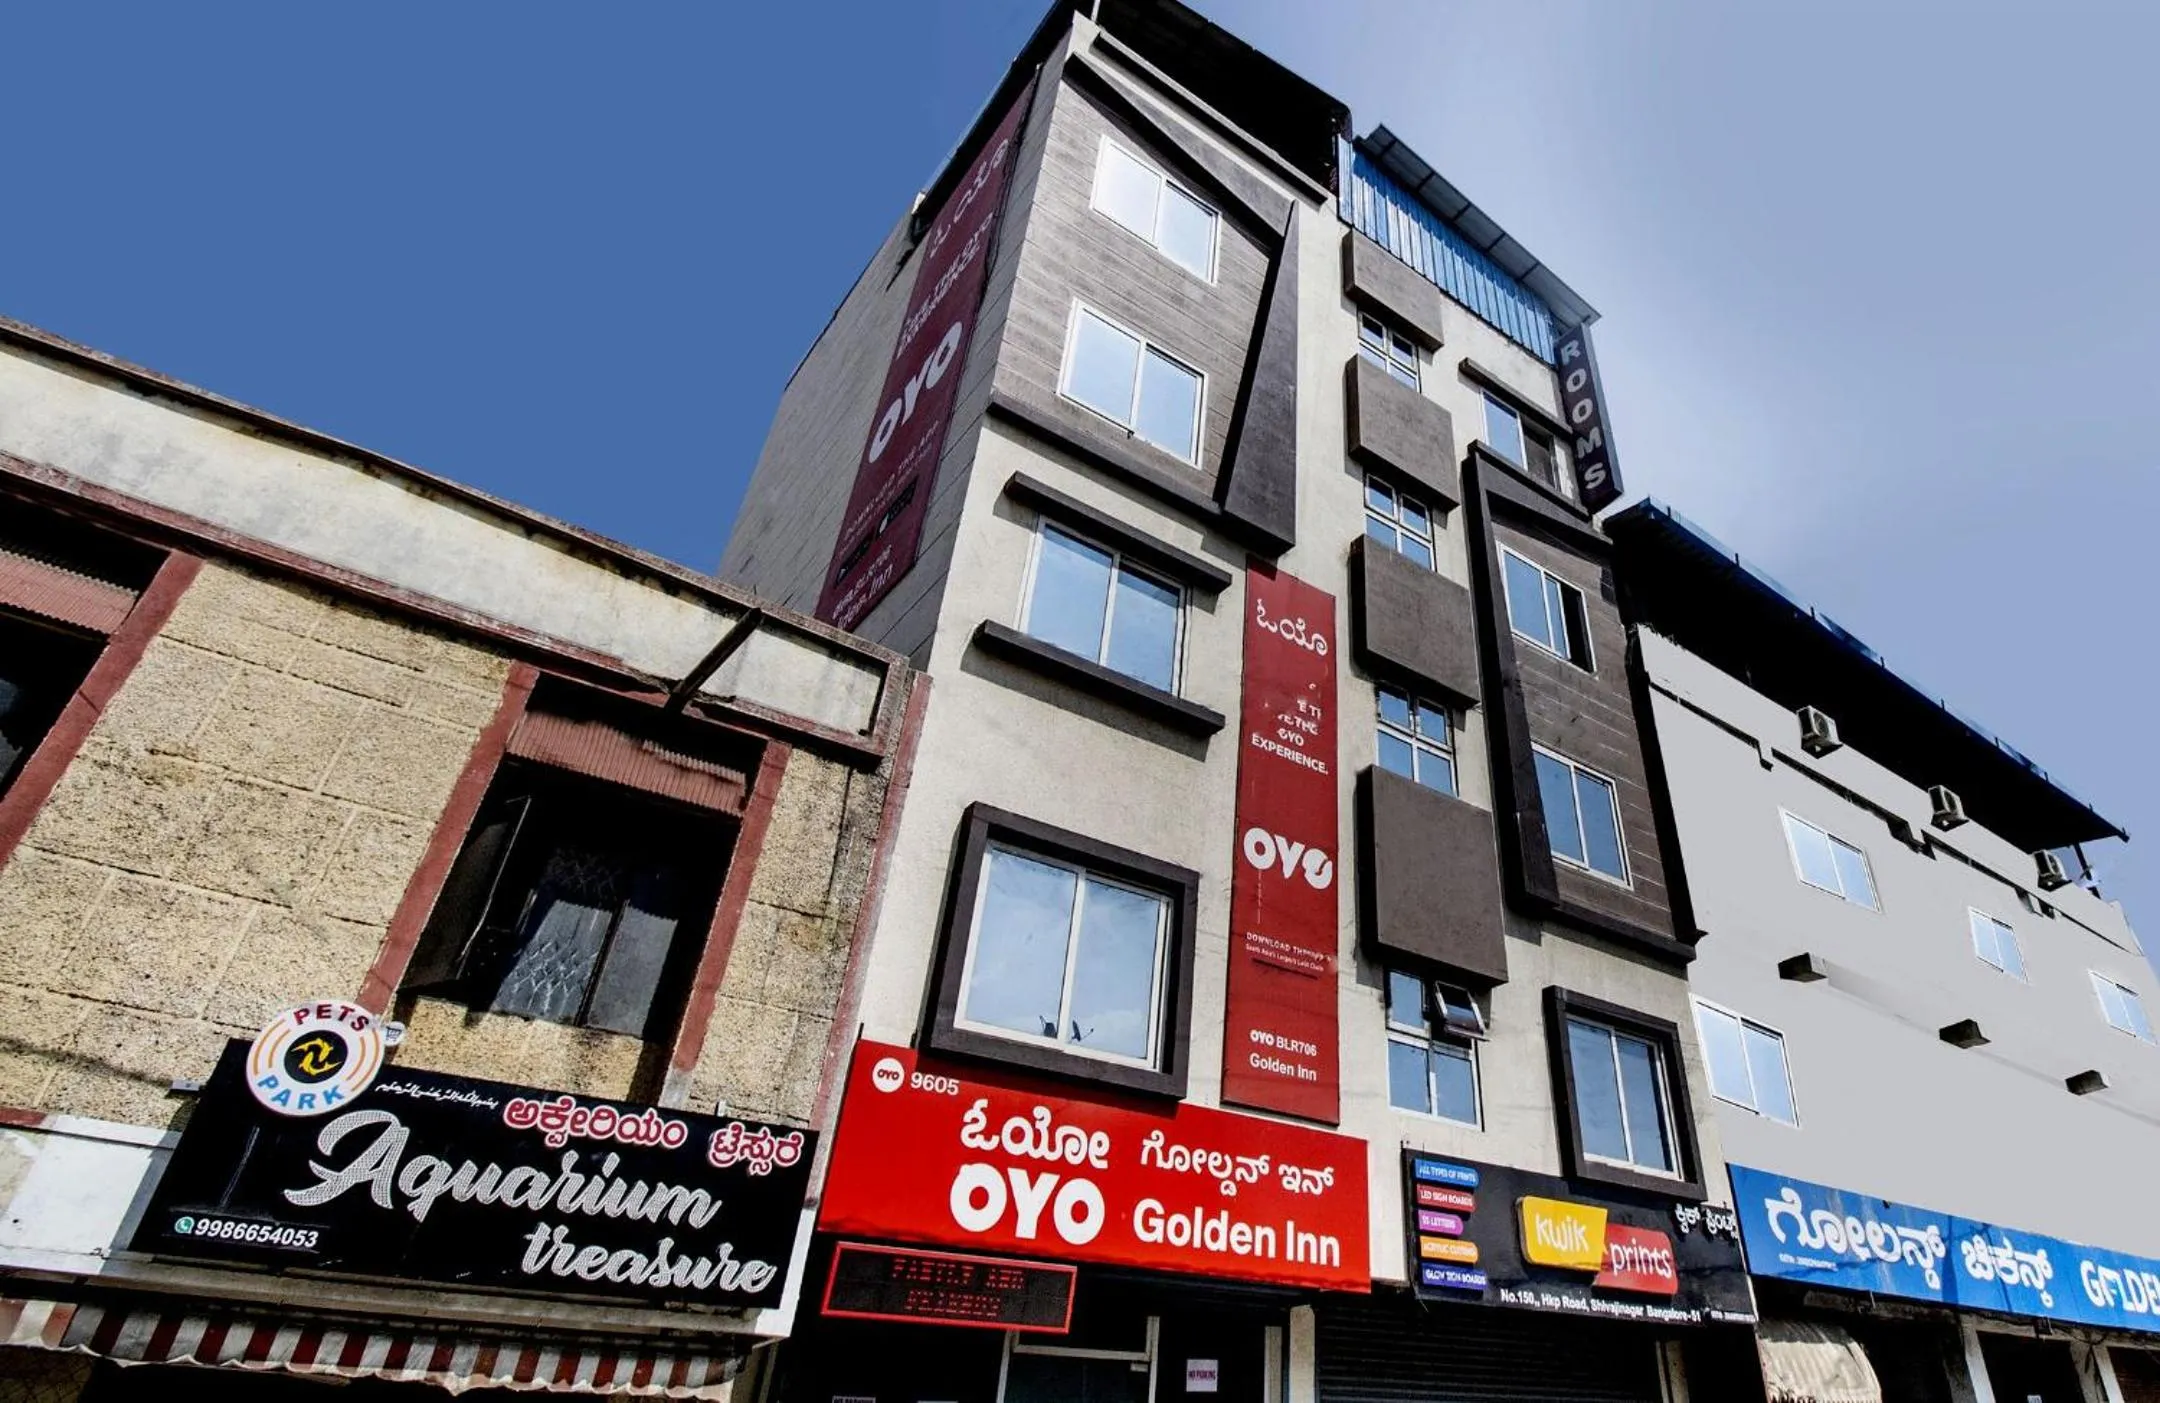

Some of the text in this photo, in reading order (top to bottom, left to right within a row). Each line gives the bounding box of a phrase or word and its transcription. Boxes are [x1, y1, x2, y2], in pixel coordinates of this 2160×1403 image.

[869, 320, 963, 464] OYO
[1560, 339, 1606, 489] ROOMS
[1251, 731, 1329, 775] EXPERIENCE.
[1243, 827, 1333, 890] OYO
[293, 1004, 369, 1032] PETS
[1250, 1029, 1317, 1057] OYO BLR706
[877, 1068, 960, 1096] OYO 9605
[1249, 1052, 1317, 1081] Golden Inn
[257, 1074, 345, 1110] PARK
[960, 1099, 1110, 1170] ಓಯೋ
[284, 1109, 722, 1229] Aquarium
[950, 1163, 1106, 1246] OYO
[194, 1218, 319, 1248] 9986654053
[1132, 1198, 1341, 1267] Golden Inn
[521, 1221, 778, 1293] treasure
[1610, 1238, 1672, 1279] prints
[1561, 1296, 1590, 1312] Road,
